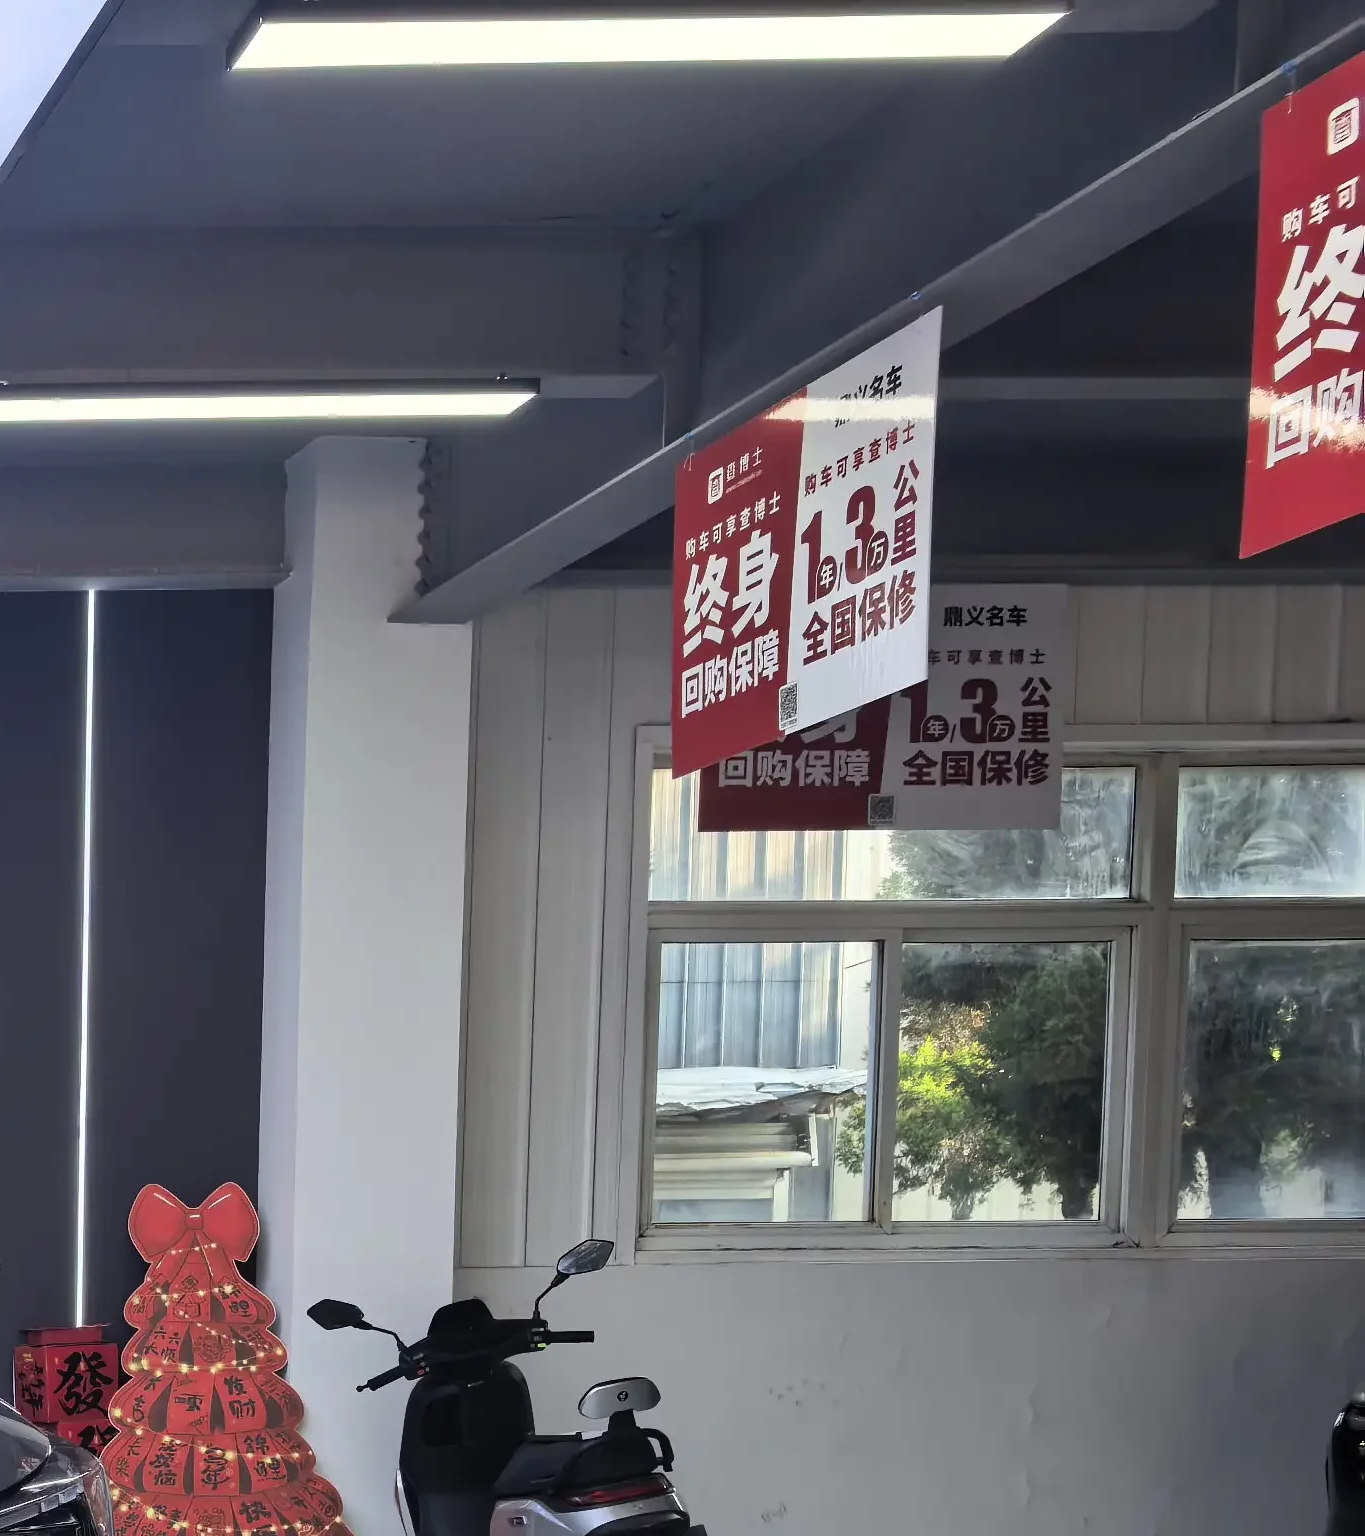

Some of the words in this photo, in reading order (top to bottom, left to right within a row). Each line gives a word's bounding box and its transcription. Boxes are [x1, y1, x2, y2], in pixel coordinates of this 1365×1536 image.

[1281, 175, 1361, 243] 购车可
[804, 418, 917, 498] 购车可享查博士
[684, 490, 781, 560] 购车可享查博士
[682, 528, 780, 660] 终身
[801, 569, 917, 667] 全国保修
[943, 605, 1028, 627] 鼎义名车
[680, 627, 780, 719] 回购保障
[718, 749, 870, 788] 回购保障
[902, 749, 1050, 787] 全国保修
